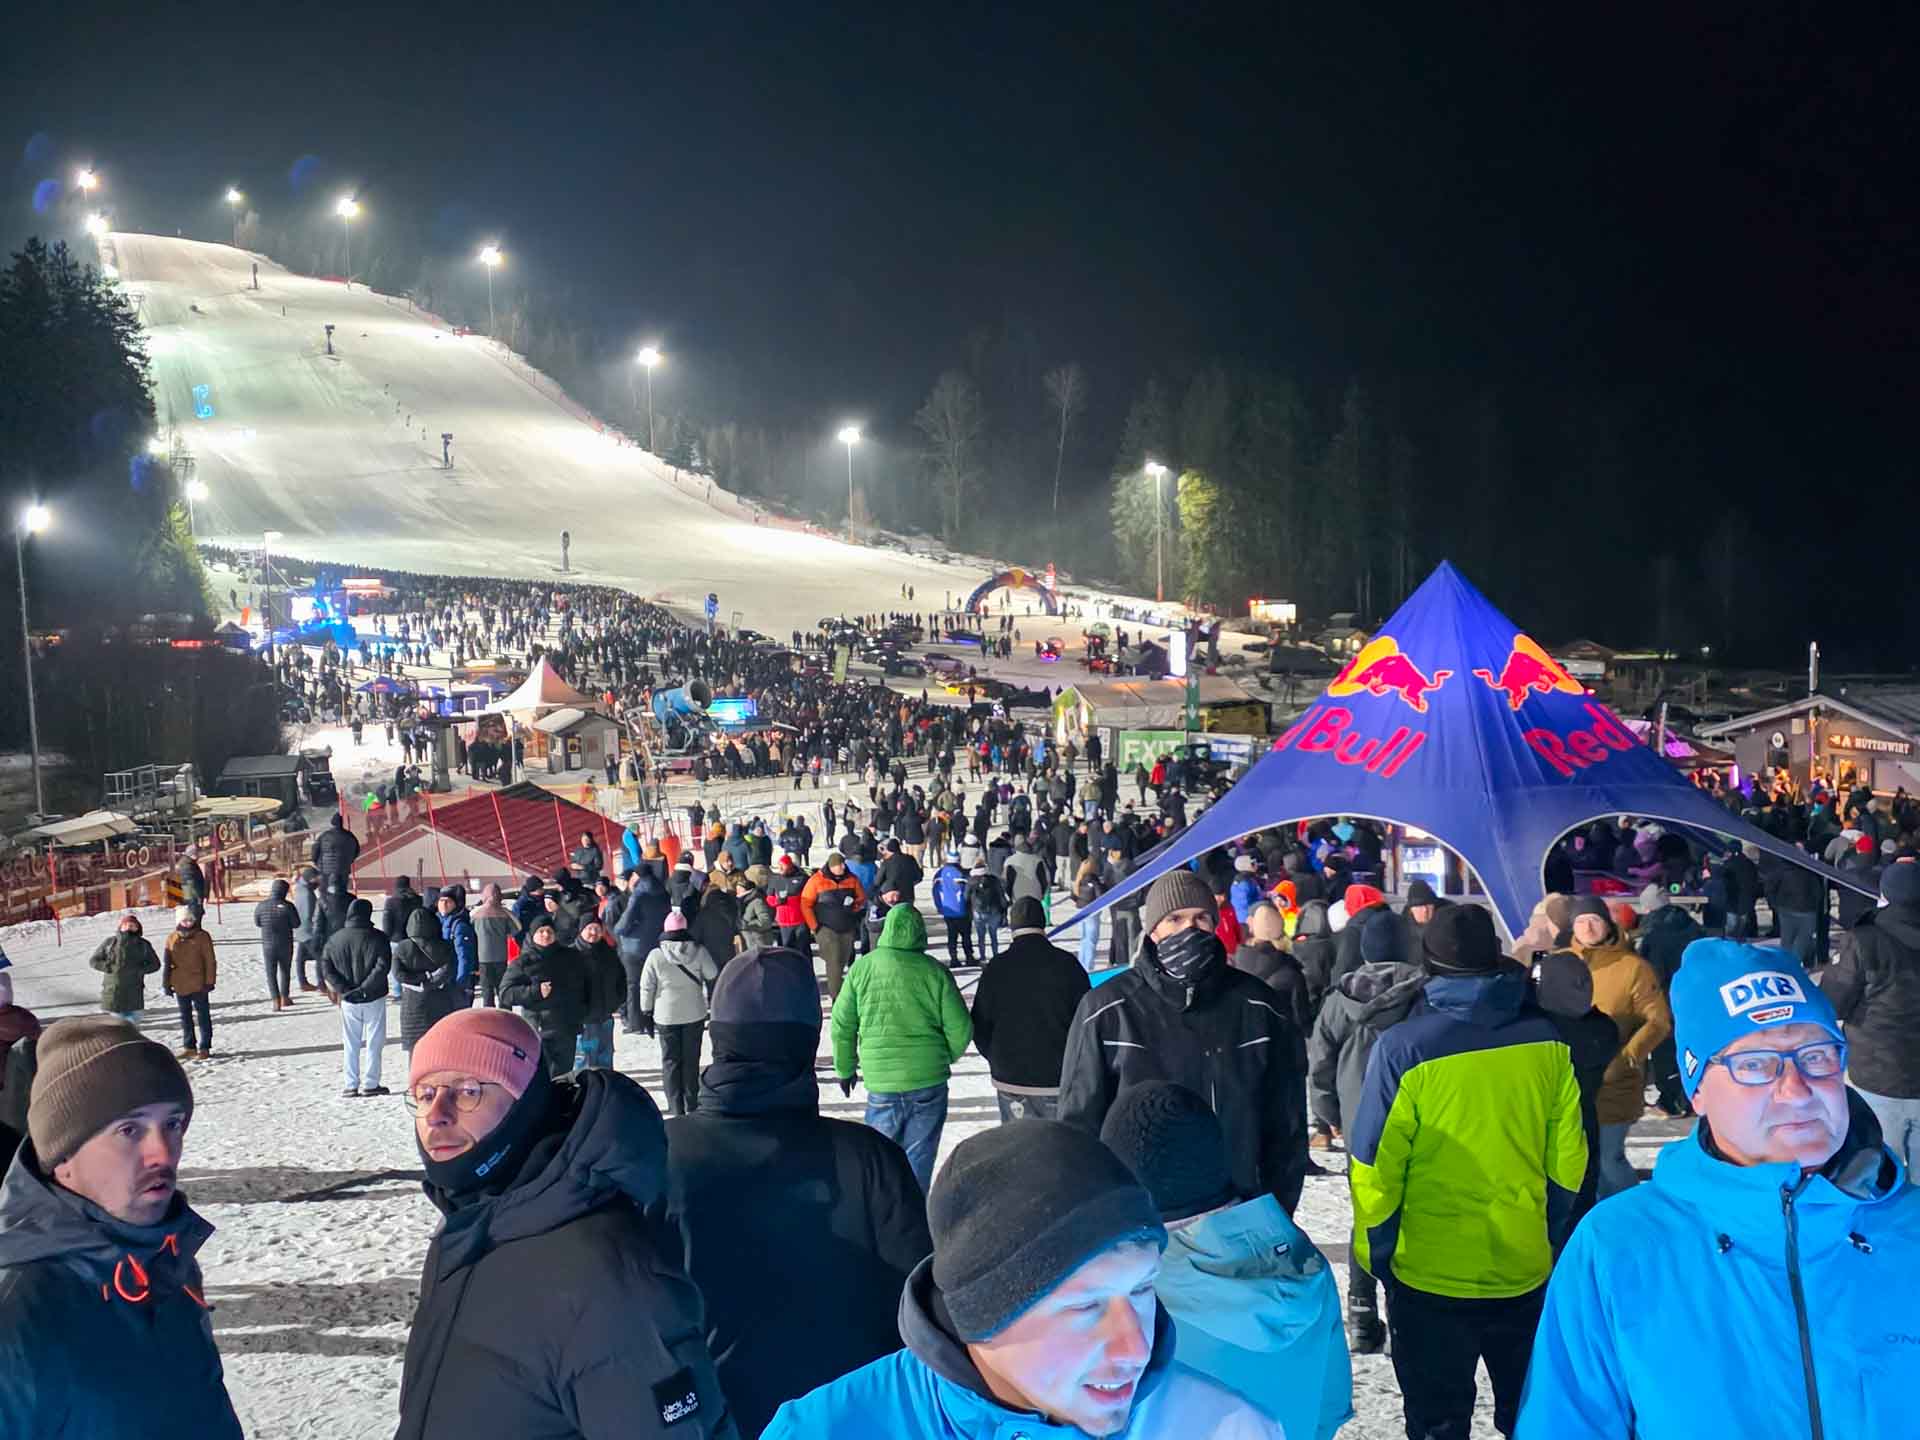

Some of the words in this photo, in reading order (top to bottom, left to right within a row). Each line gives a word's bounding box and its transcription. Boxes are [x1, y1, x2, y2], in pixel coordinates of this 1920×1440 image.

[1297, 706, 1426, 778] Bull
[1522, 702, 1634, 777] Red
[1728, 976, 1796, 1008] DKB
[1885, 1333, 1920, 1345] ON
[663, 1400, 683, 1414] Jack
